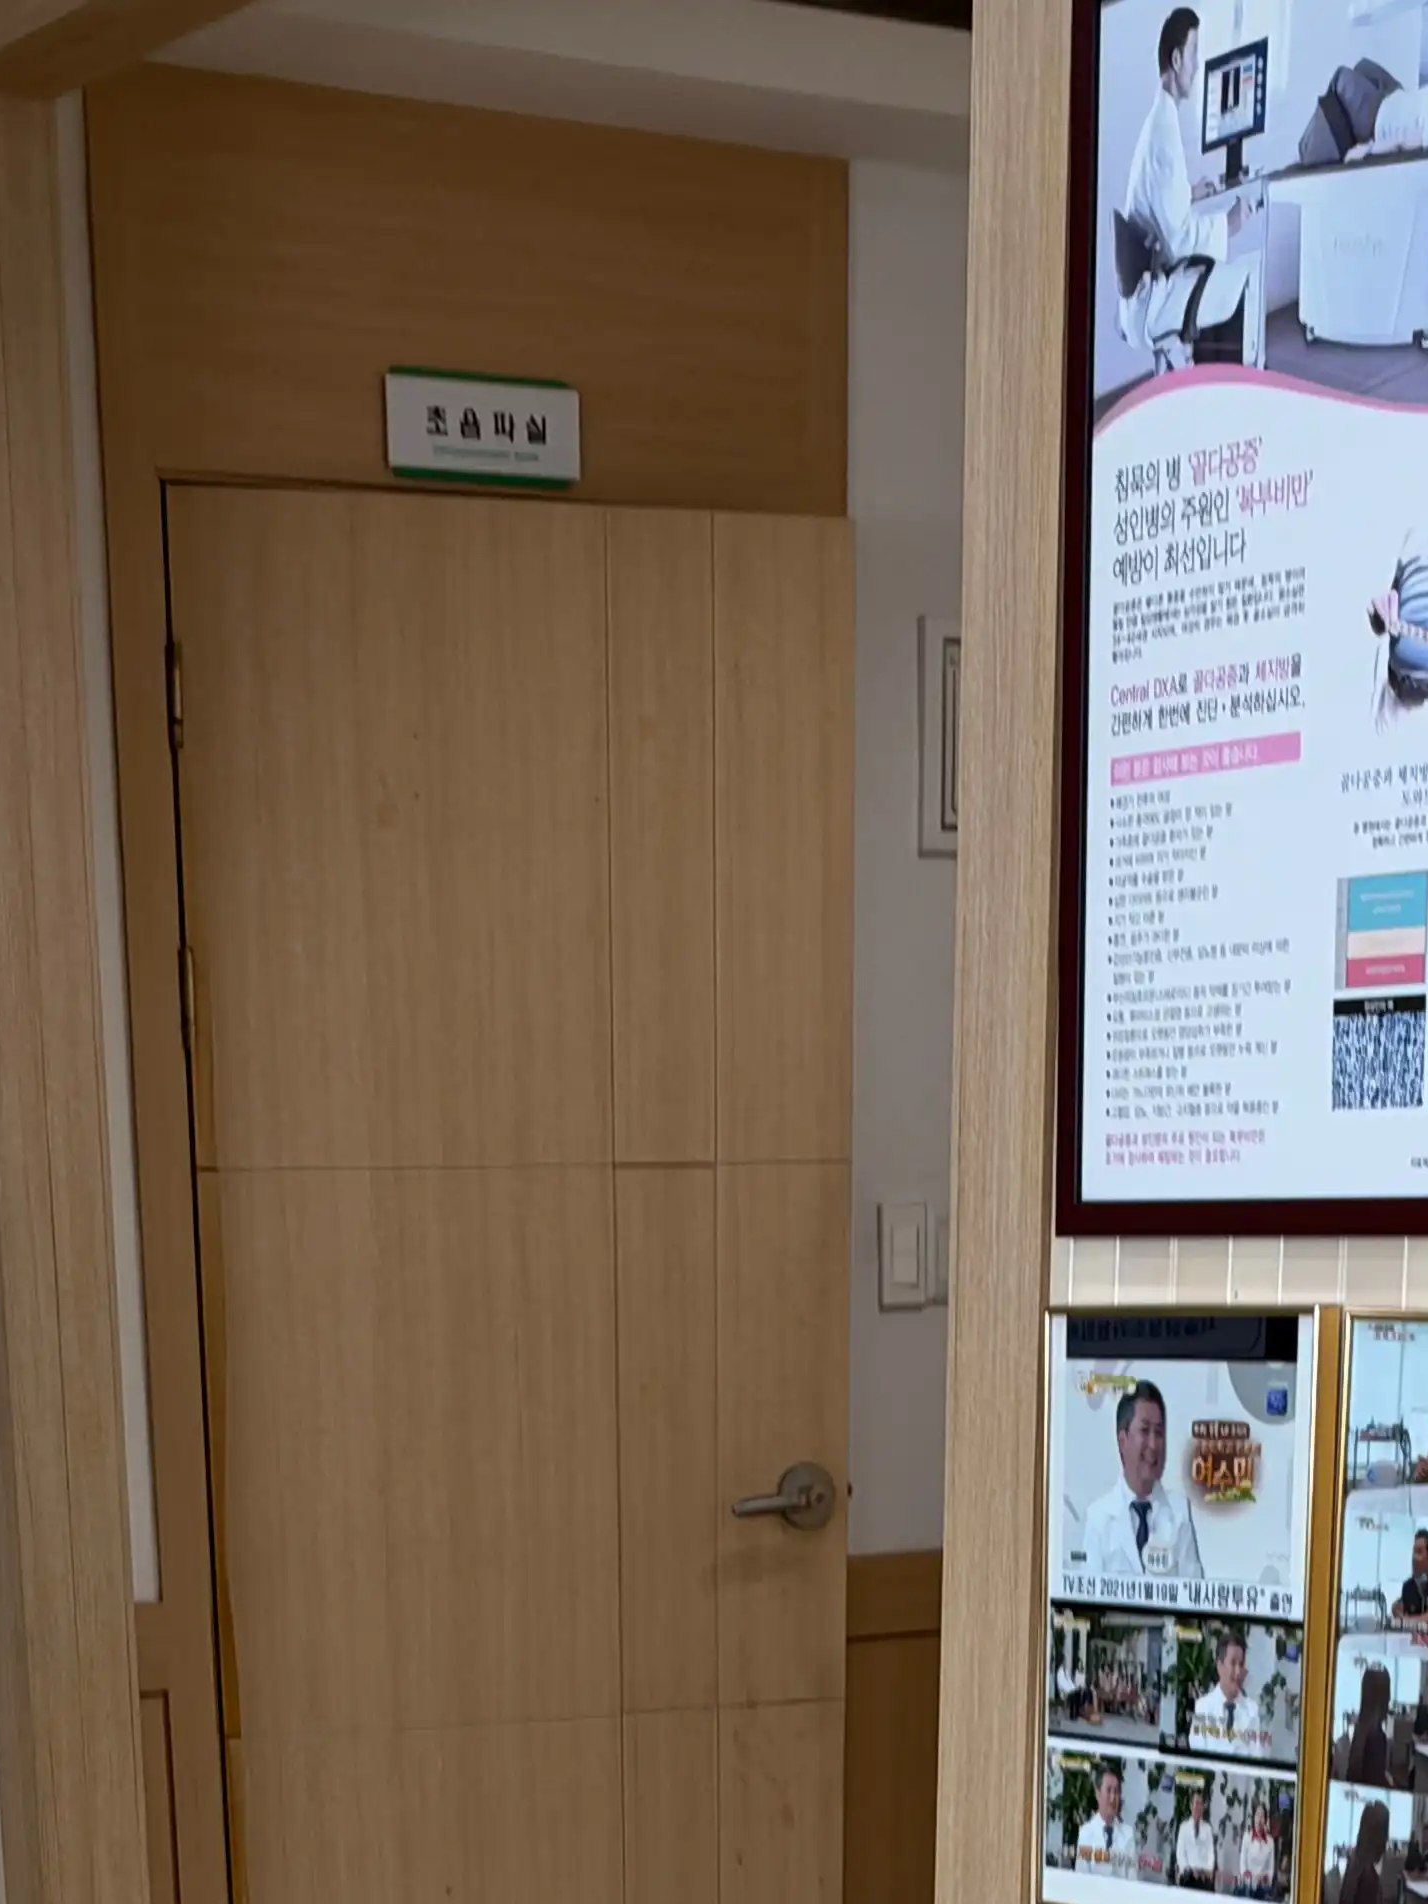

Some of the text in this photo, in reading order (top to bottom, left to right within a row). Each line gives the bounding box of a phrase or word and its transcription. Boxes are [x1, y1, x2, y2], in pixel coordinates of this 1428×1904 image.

[1115, 458, 1160, 504] 침묵의
[1166, 454, 1181, 491] 병
[1114, 499, 1175, 546] 성인병의
[1181, 487, 1230, 531] 주원인
[1113, 527, 1246, 586] 예방이 최선입니다
